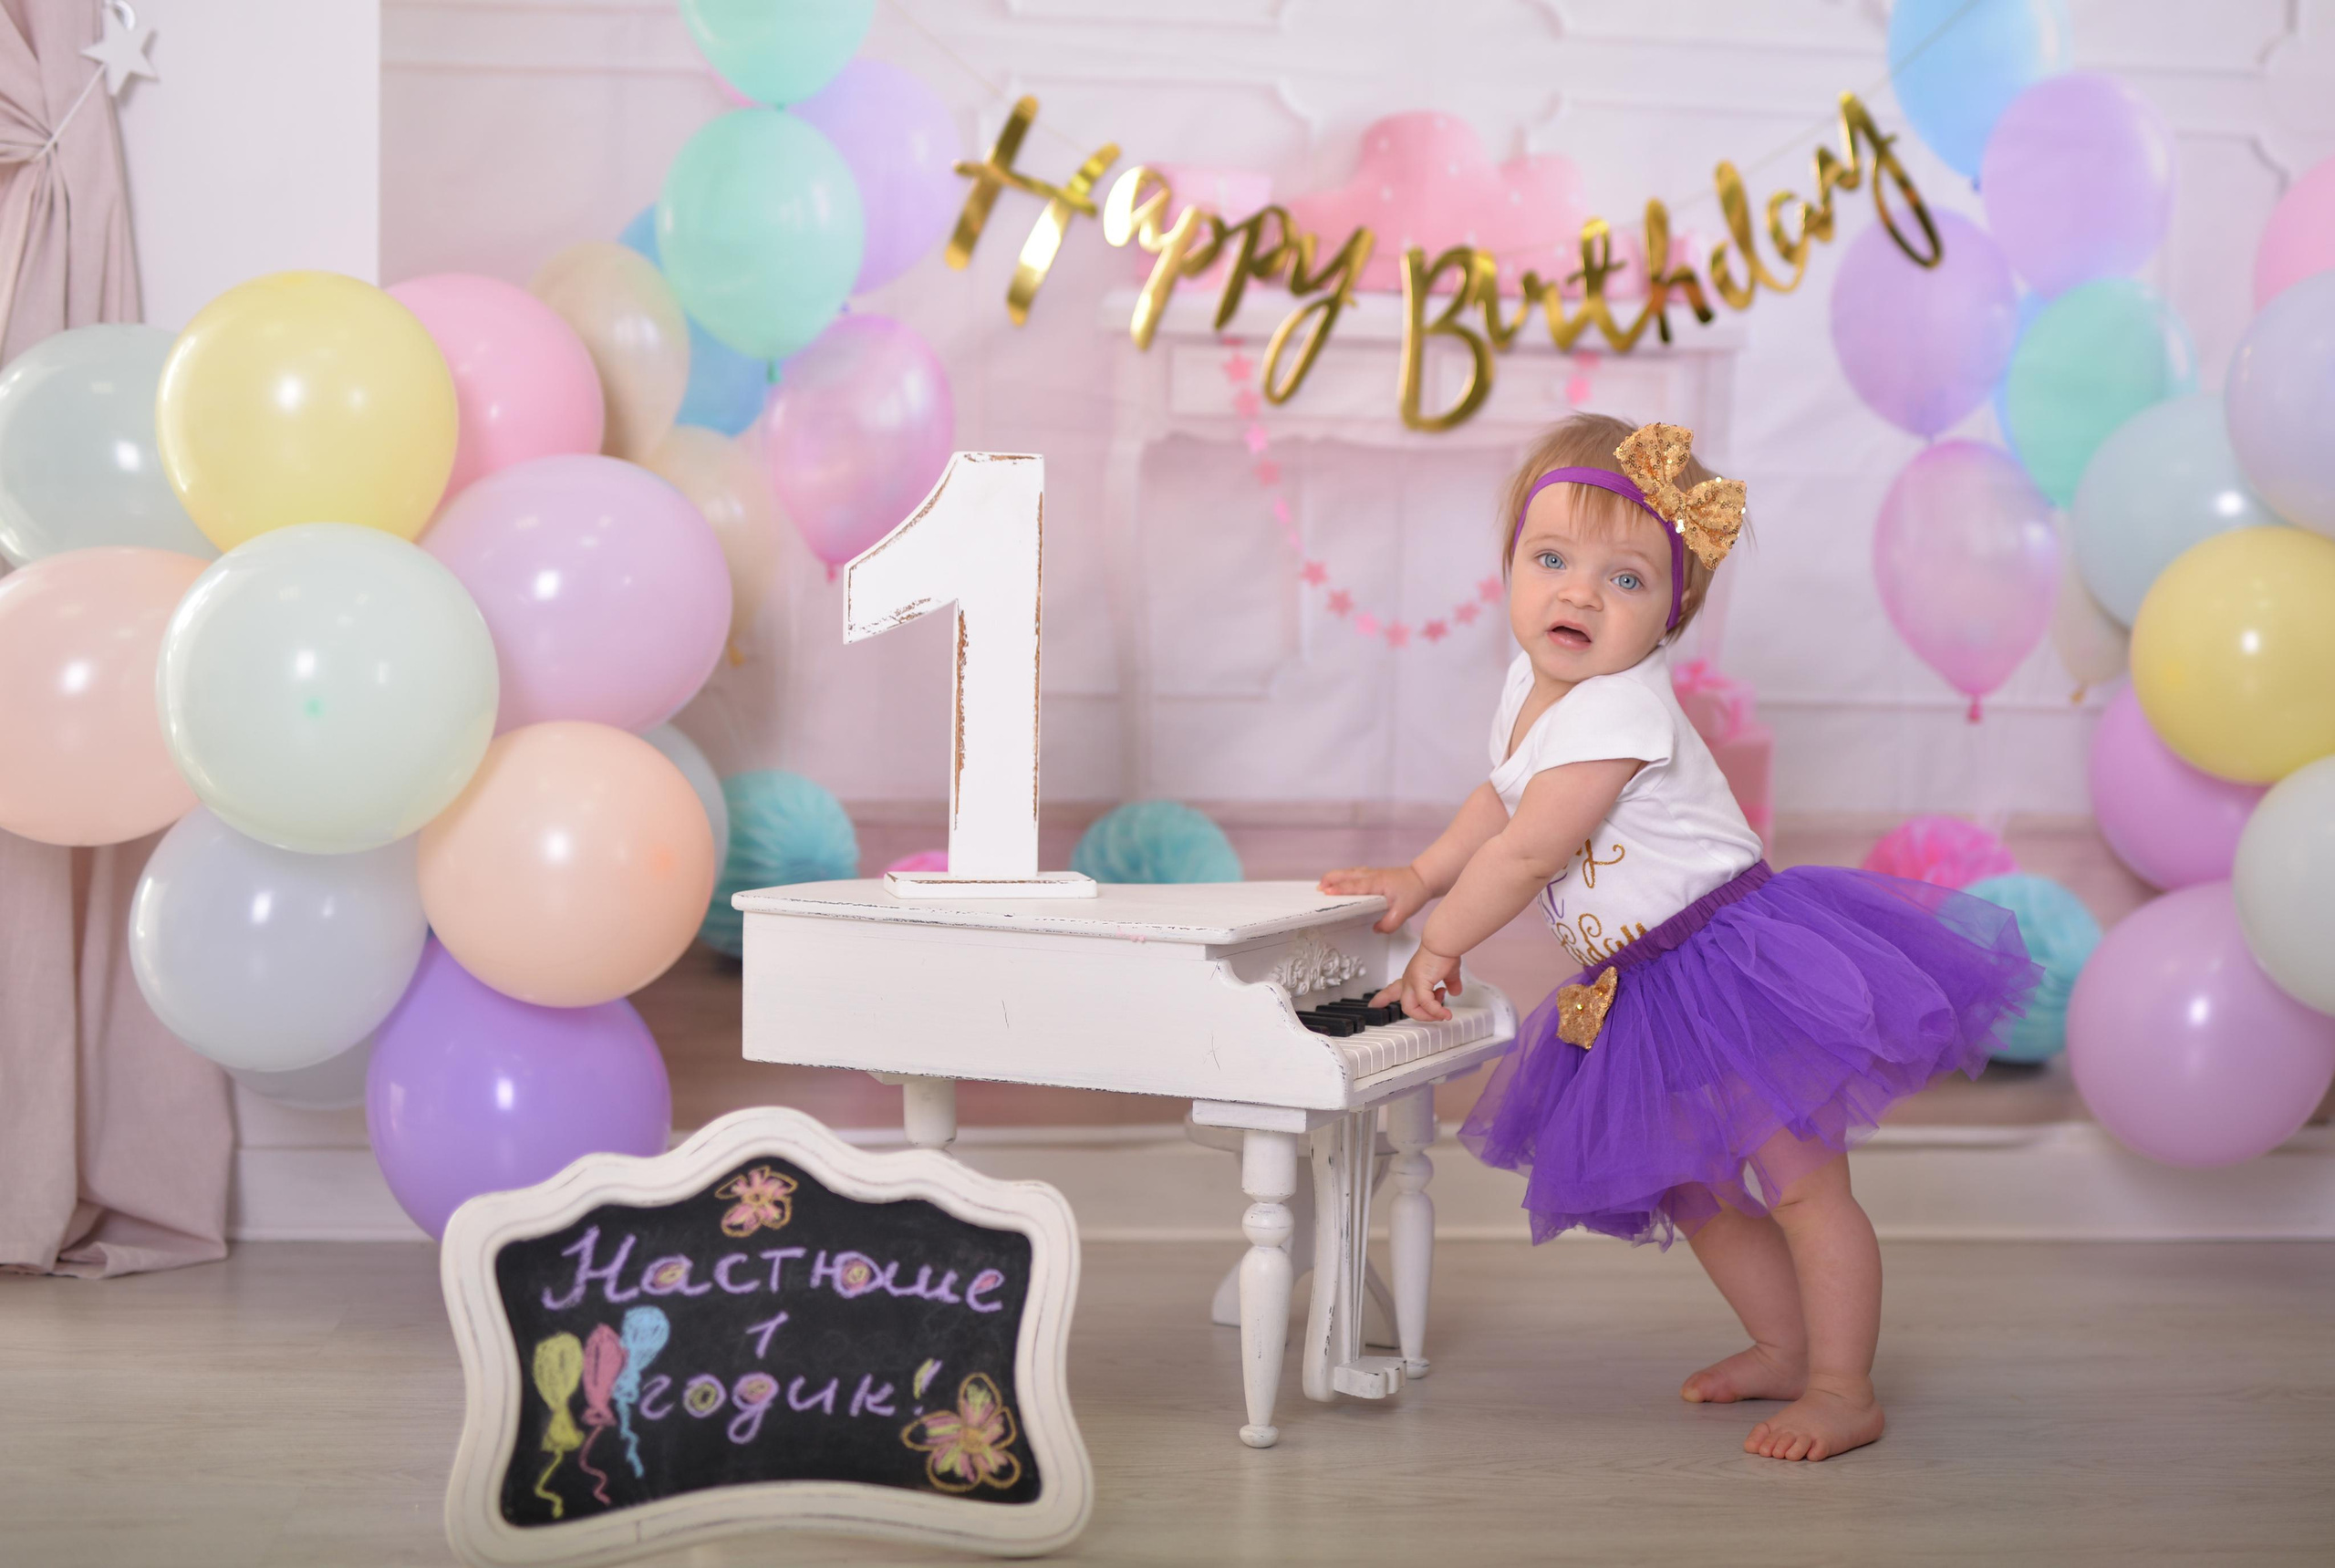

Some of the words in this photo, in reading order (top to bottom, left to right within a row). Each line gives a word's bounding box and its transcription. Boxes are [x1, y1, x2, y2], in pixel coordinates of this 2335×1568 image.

[953, 95, 1375, 405] Happy
[1399, 91, 1944, 431] Birthday
[844, 452, 1044, 877] 1
[543, 1226, 1004, 1312] Настюше
[747, 1313, 789, 1358] 1
[639, 1359, 942, 1444] годик!
